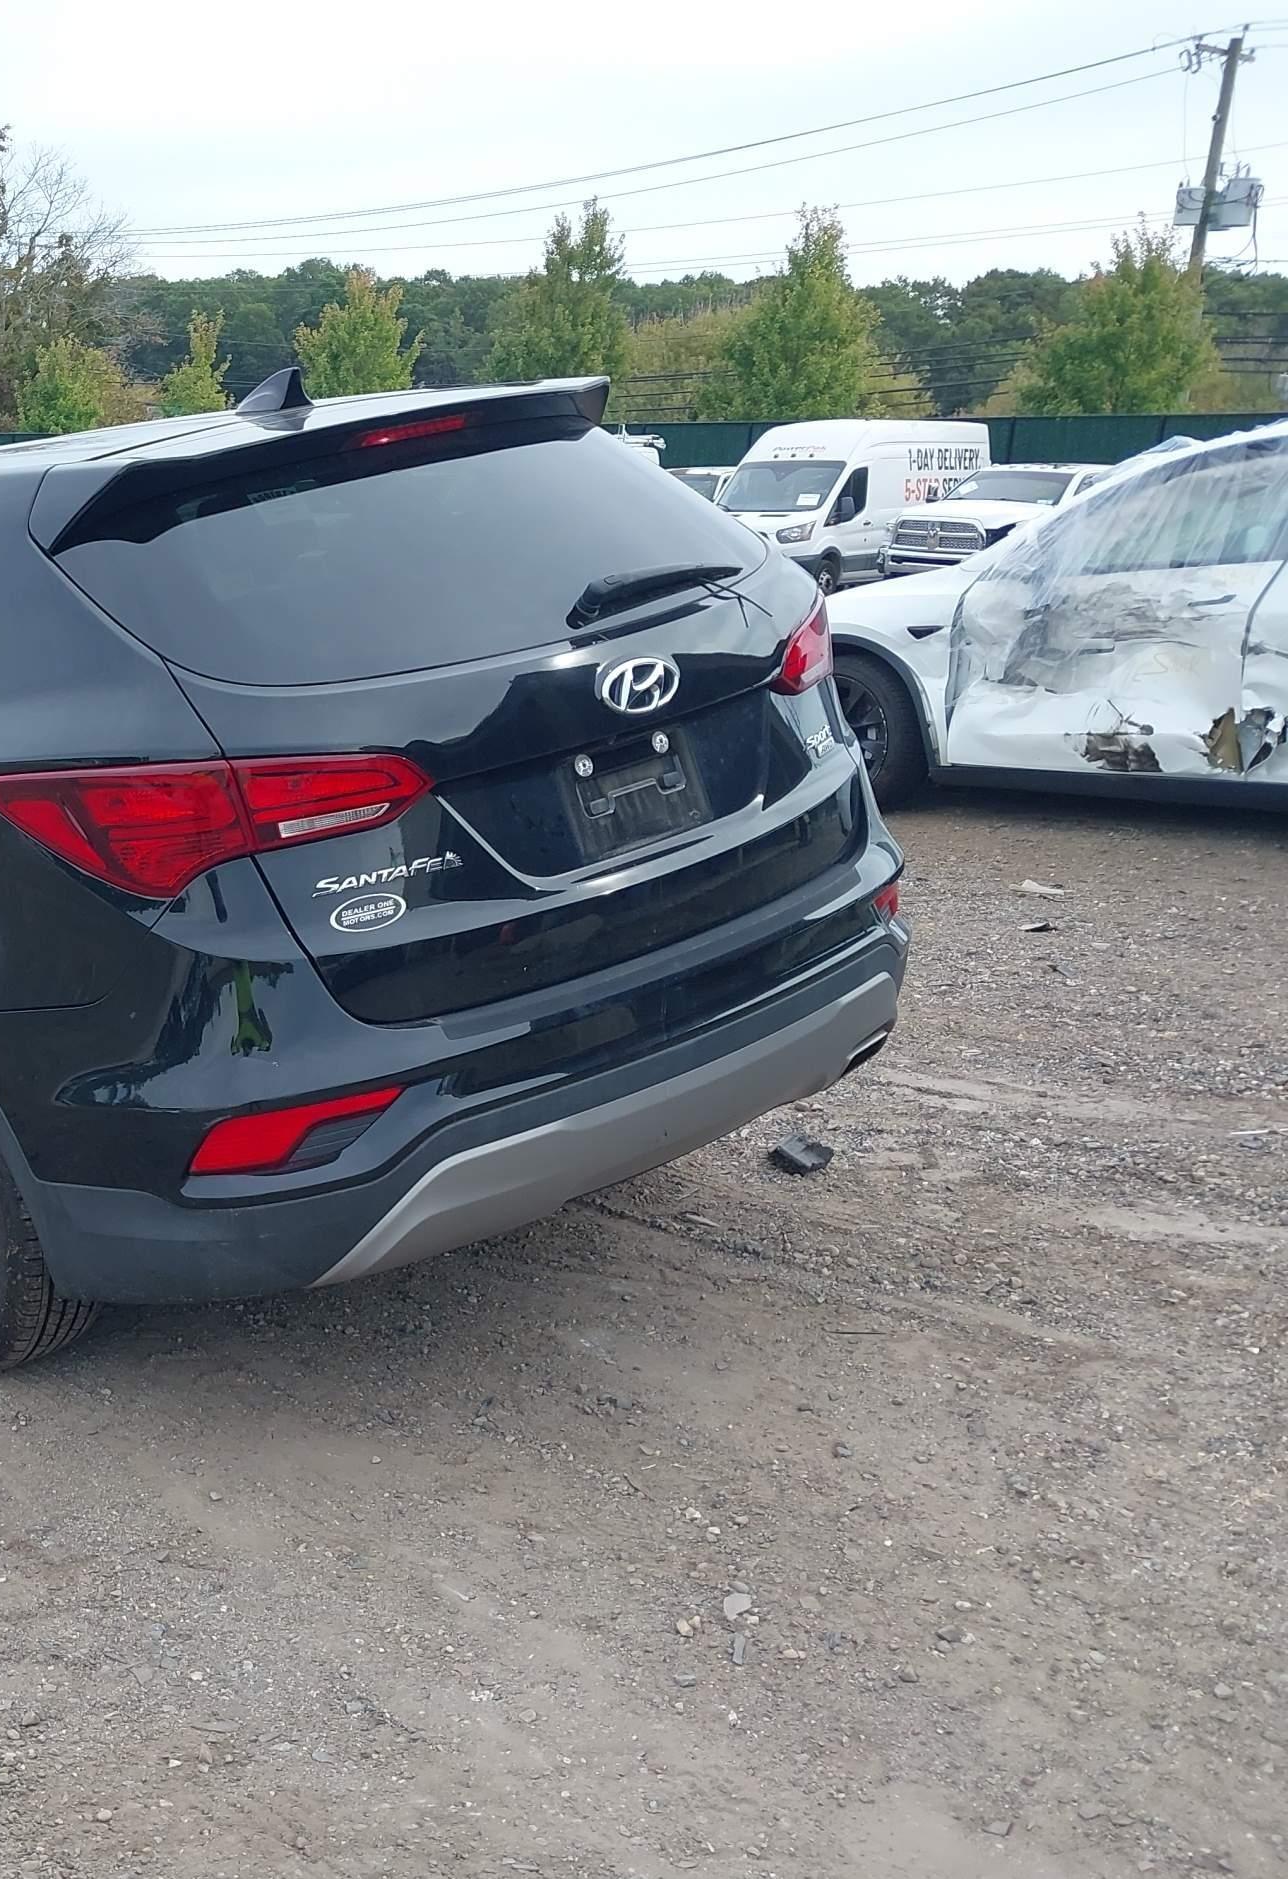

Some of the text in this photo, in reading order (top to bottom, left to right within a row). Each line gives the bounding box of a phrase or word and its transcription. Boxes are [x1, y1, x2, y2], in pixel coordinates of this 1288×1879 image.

[908, 448, 934, 471] 1-DAY
[905, 478, 940, 501] 5-ST
[806, 725, 832, 750] Sport
[341, 898, 395, 918] DEALER ONE
[342, 909, 394, 927] MOTORS.COM
